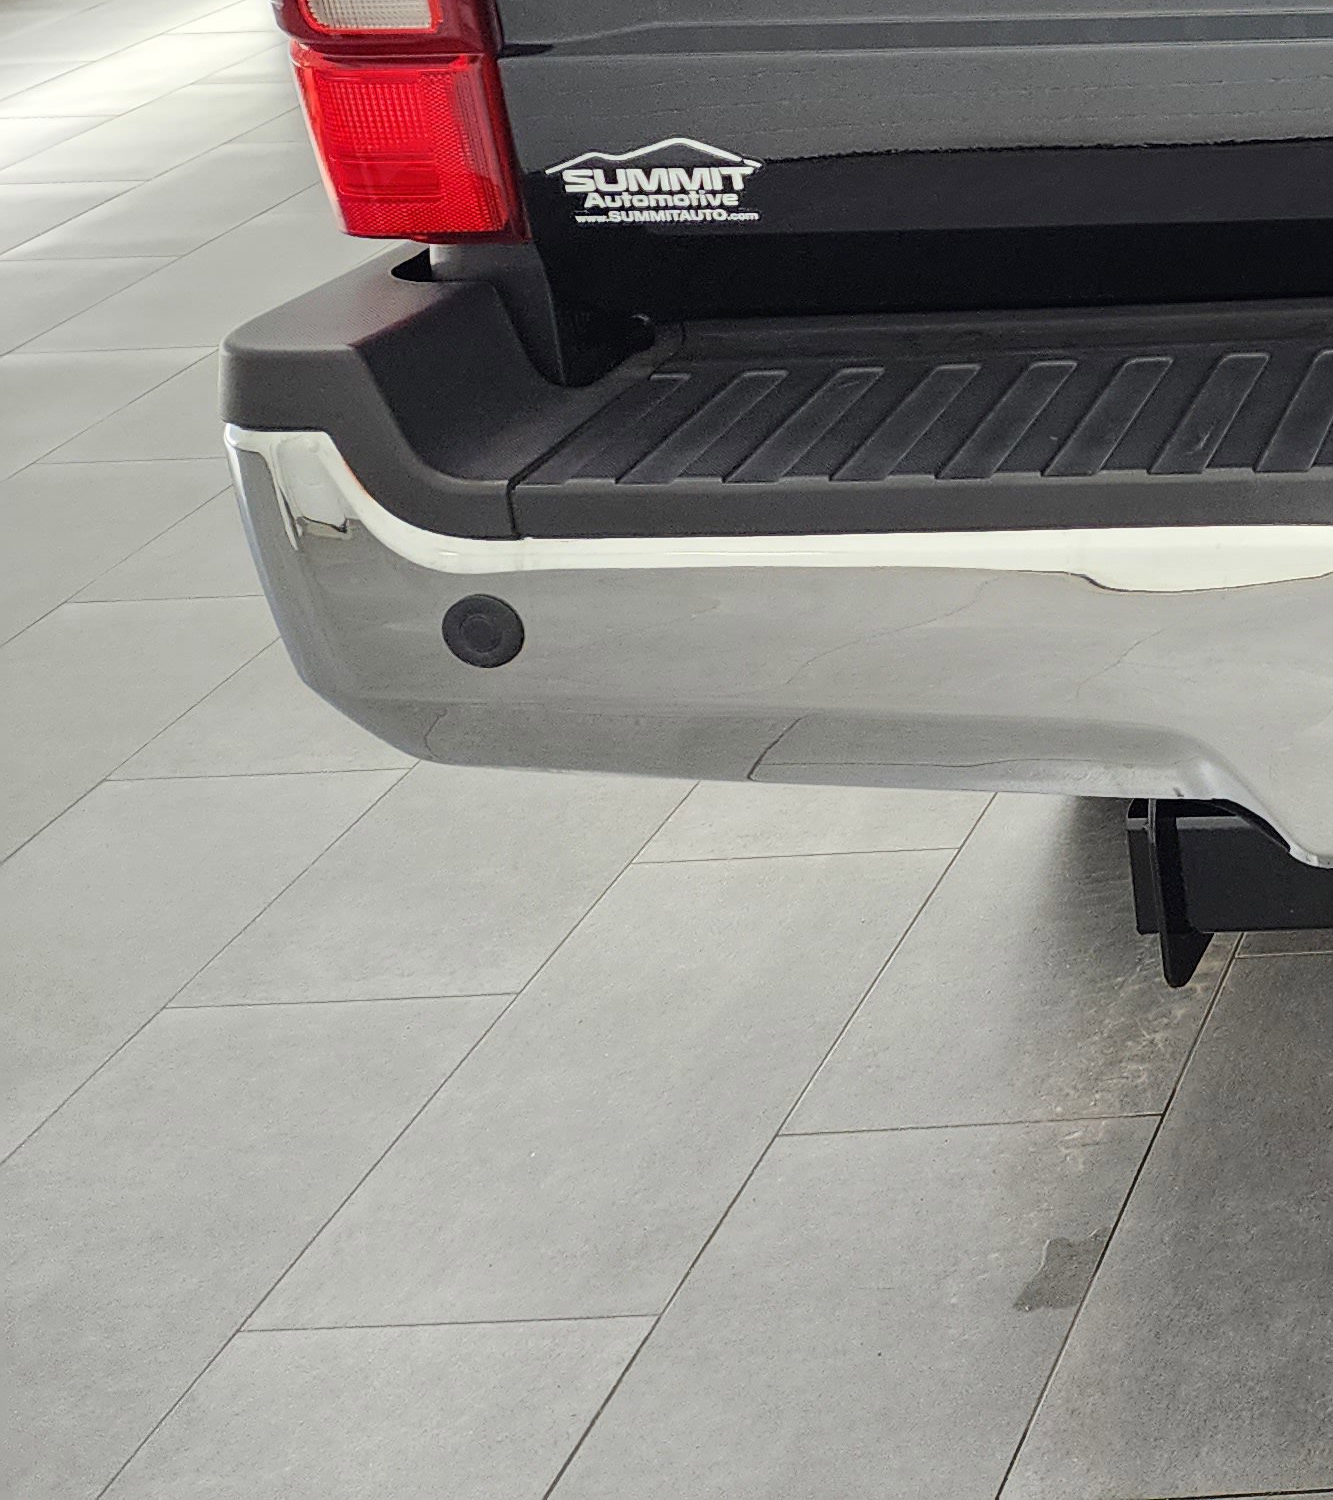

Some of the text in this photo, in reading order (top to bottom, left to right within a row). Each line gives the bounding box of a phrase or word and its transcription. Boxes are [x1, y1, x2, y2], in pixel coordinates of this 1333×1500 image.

[562, 166, 754, 192] SUMMIT
[584, 190, 739, 208] Automotive
[575, 209, 759, 223] www.SUMMITAUTO.com
